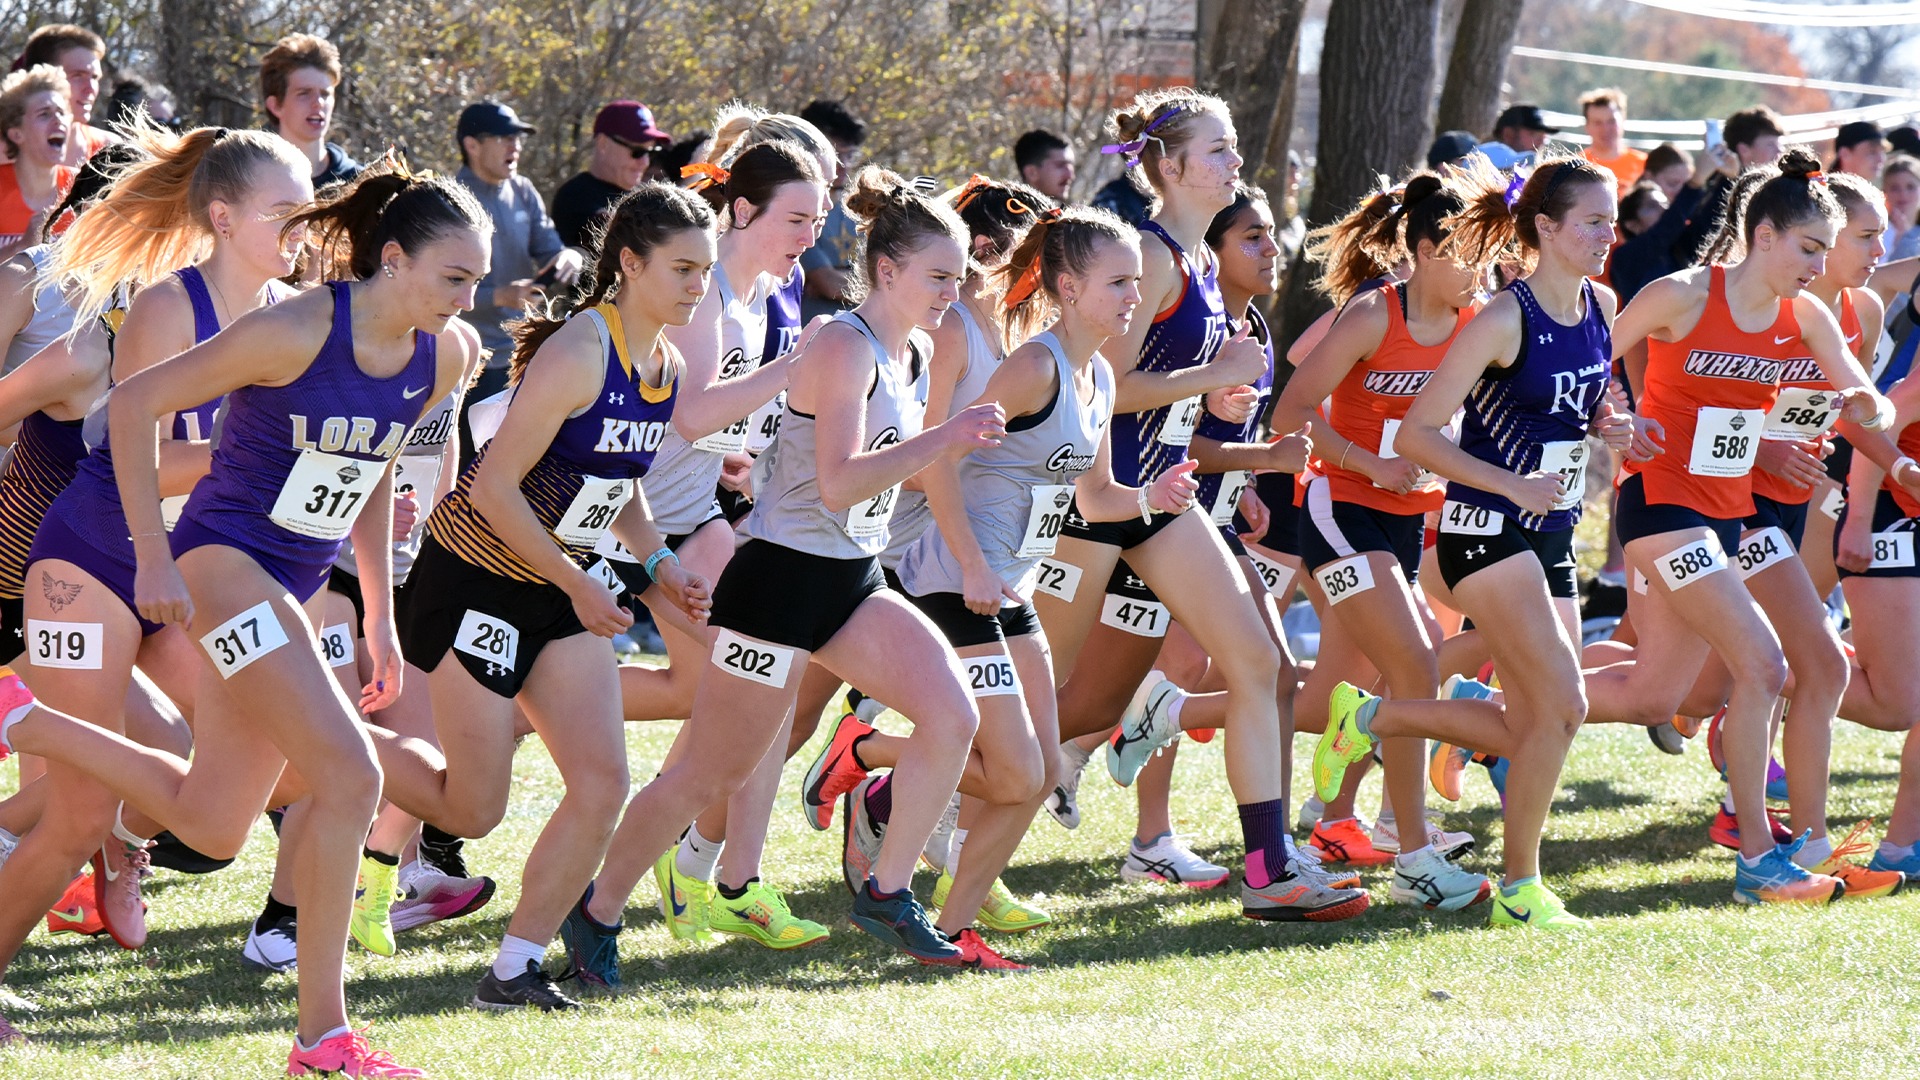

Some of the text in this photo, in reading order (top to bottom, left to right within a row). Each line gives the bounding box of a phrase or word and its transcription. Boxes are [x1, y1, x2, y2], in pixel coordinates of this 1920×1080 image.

[1684, 349, 1781, 384] WHEATO
[1780, 407, 1829, 428] 584
[594, 417, 665, 452] KNO
[1712, 435, 1749, 459] 588
[305, 485, 362, 519] 317
[578, 504, 619, 530] 281
[1448, 503, 1489, 528] 470
[1669, 547, 1713, 581] 588
[1738, 535, 1778, 572] 584
[1875, 539, 1899, 561] 81
[1323, 566, 1360, 598] 583
[1115, 603, 1159, 631] 471
[38, 629, 86, 662] 319
[214, 617, 262, 666] 317
[472, 622, 512, 658] 281
[724, 642, 776, 677] 202
[968, 662, 1014, 690] 205
